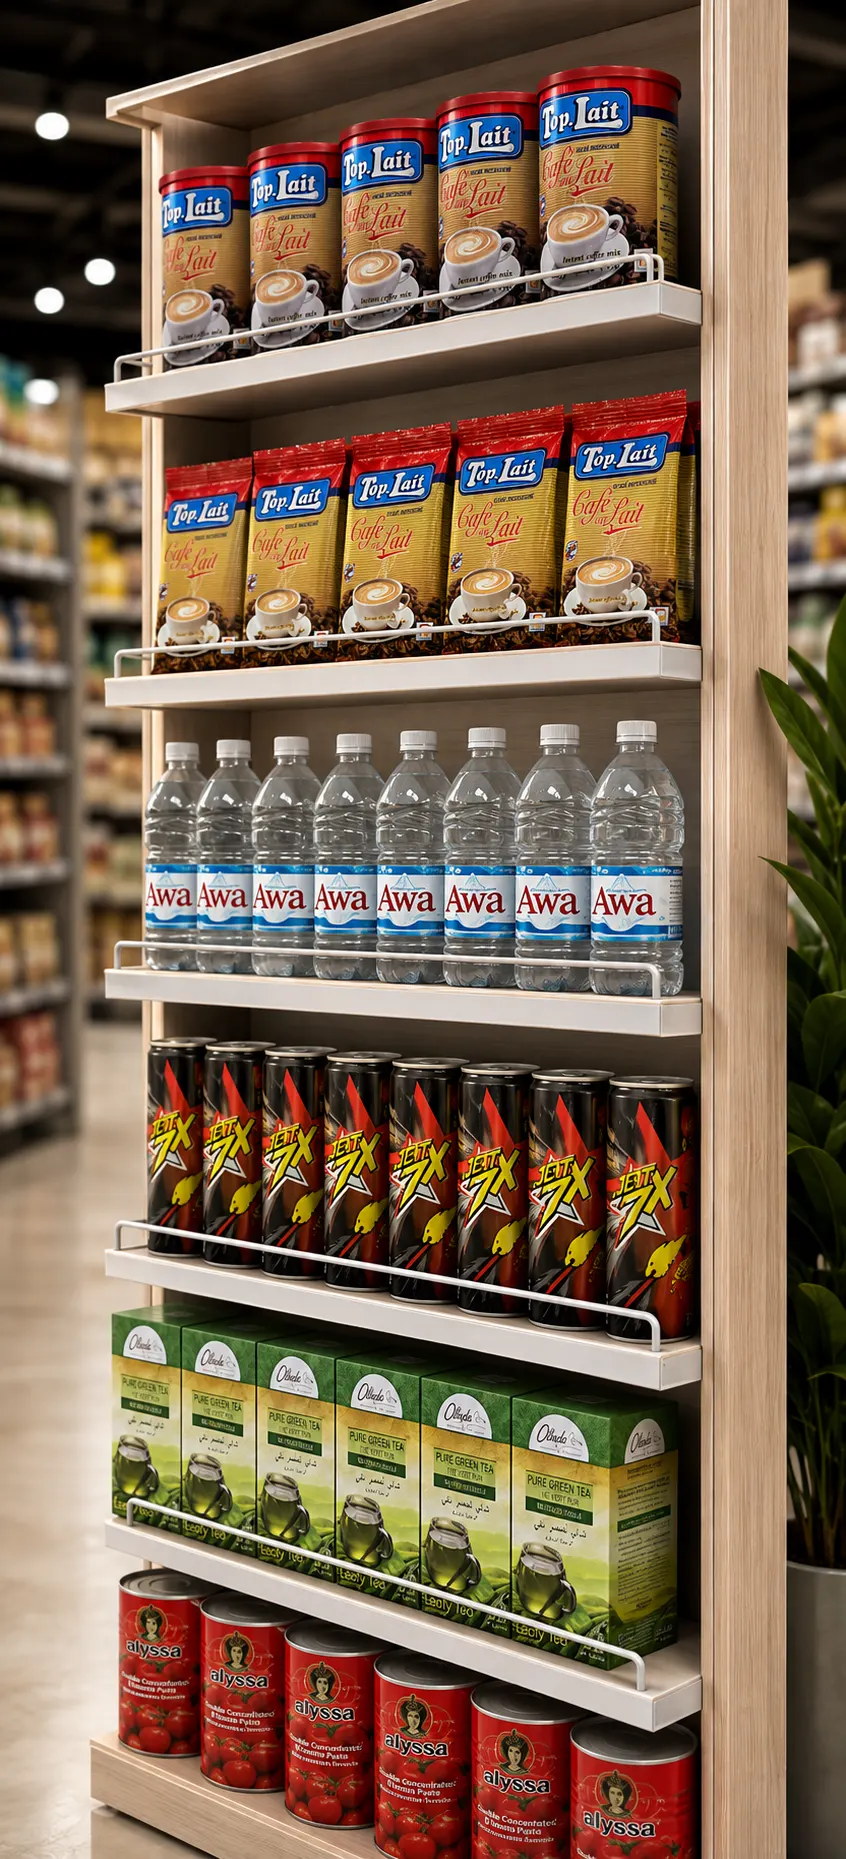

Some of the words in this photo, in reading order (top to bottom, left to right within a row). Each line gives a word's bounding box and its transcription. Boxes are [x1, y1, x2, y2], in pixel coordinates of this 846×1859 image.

[571, 156, 614, 196] Lait
[465, 178, 506, 218] Lait
[368, 202, 406, 240] Lait
[274, 224, 311, 260] Lait
[182, 245, 217, 280] Lait
[487, 510, 523, 546] Lait
[603, 497, 644, 535] Lait
[277, 536, 310, 570] Lait
[376, 524, 413, 559] Lait
[187, 548, 218, 579] Lait
[146, 882, 193, 908] Awa
[197, 882, 248, 908] Awa
[253, 883, 307, 910] Awa
[315, 883, 369, 911] Awa
[378, 884, 436, 912] Awa
[446, 885, 506, 913] Awa
[517, 885, 580, 915] Awa
[592, 886, 656, 916] Awa
[122, 1377, 136, 1388] PURE
[138, 1381, 156, 1392] GREEN
[158, 1385, 168, 1395] TEA
[194, 1394, 209, 1405] PURE
[211, 1397, 229, 1409] GREEN
[231, 1401, 242, 1412] TEA
[269, 1412, 285, 1424] PURE
[287, 1416, 307, 1429] GREEN
[308, 1420, 320, 1431] TEA
[350, 1431, 366, 1442] PURE
[368, 1435, 390, 1449] GREEN
[391, 1440, 404, 1451] TEA
[436, 1452, 453, 1465] PURE
[455, 1456, 478, 1471] GREEN
[480, 1461, 493, 1474] TEA
[528, 1475, 546, 1487] PURE
[549, 1479, 575, 1494] GREEN
[576, 1485, 591, 1498] TEA
[126, 1640, 182, 1659] alyssa
[210, 1668, 268, 1689] alyssa
[295, 1700, 355, 1721] alyssa
[384, 1734, 449, 1756] alyssa
[483, 1769, 550, 1793] alyssa
[583, 1811, 656, 1837] alyssa
